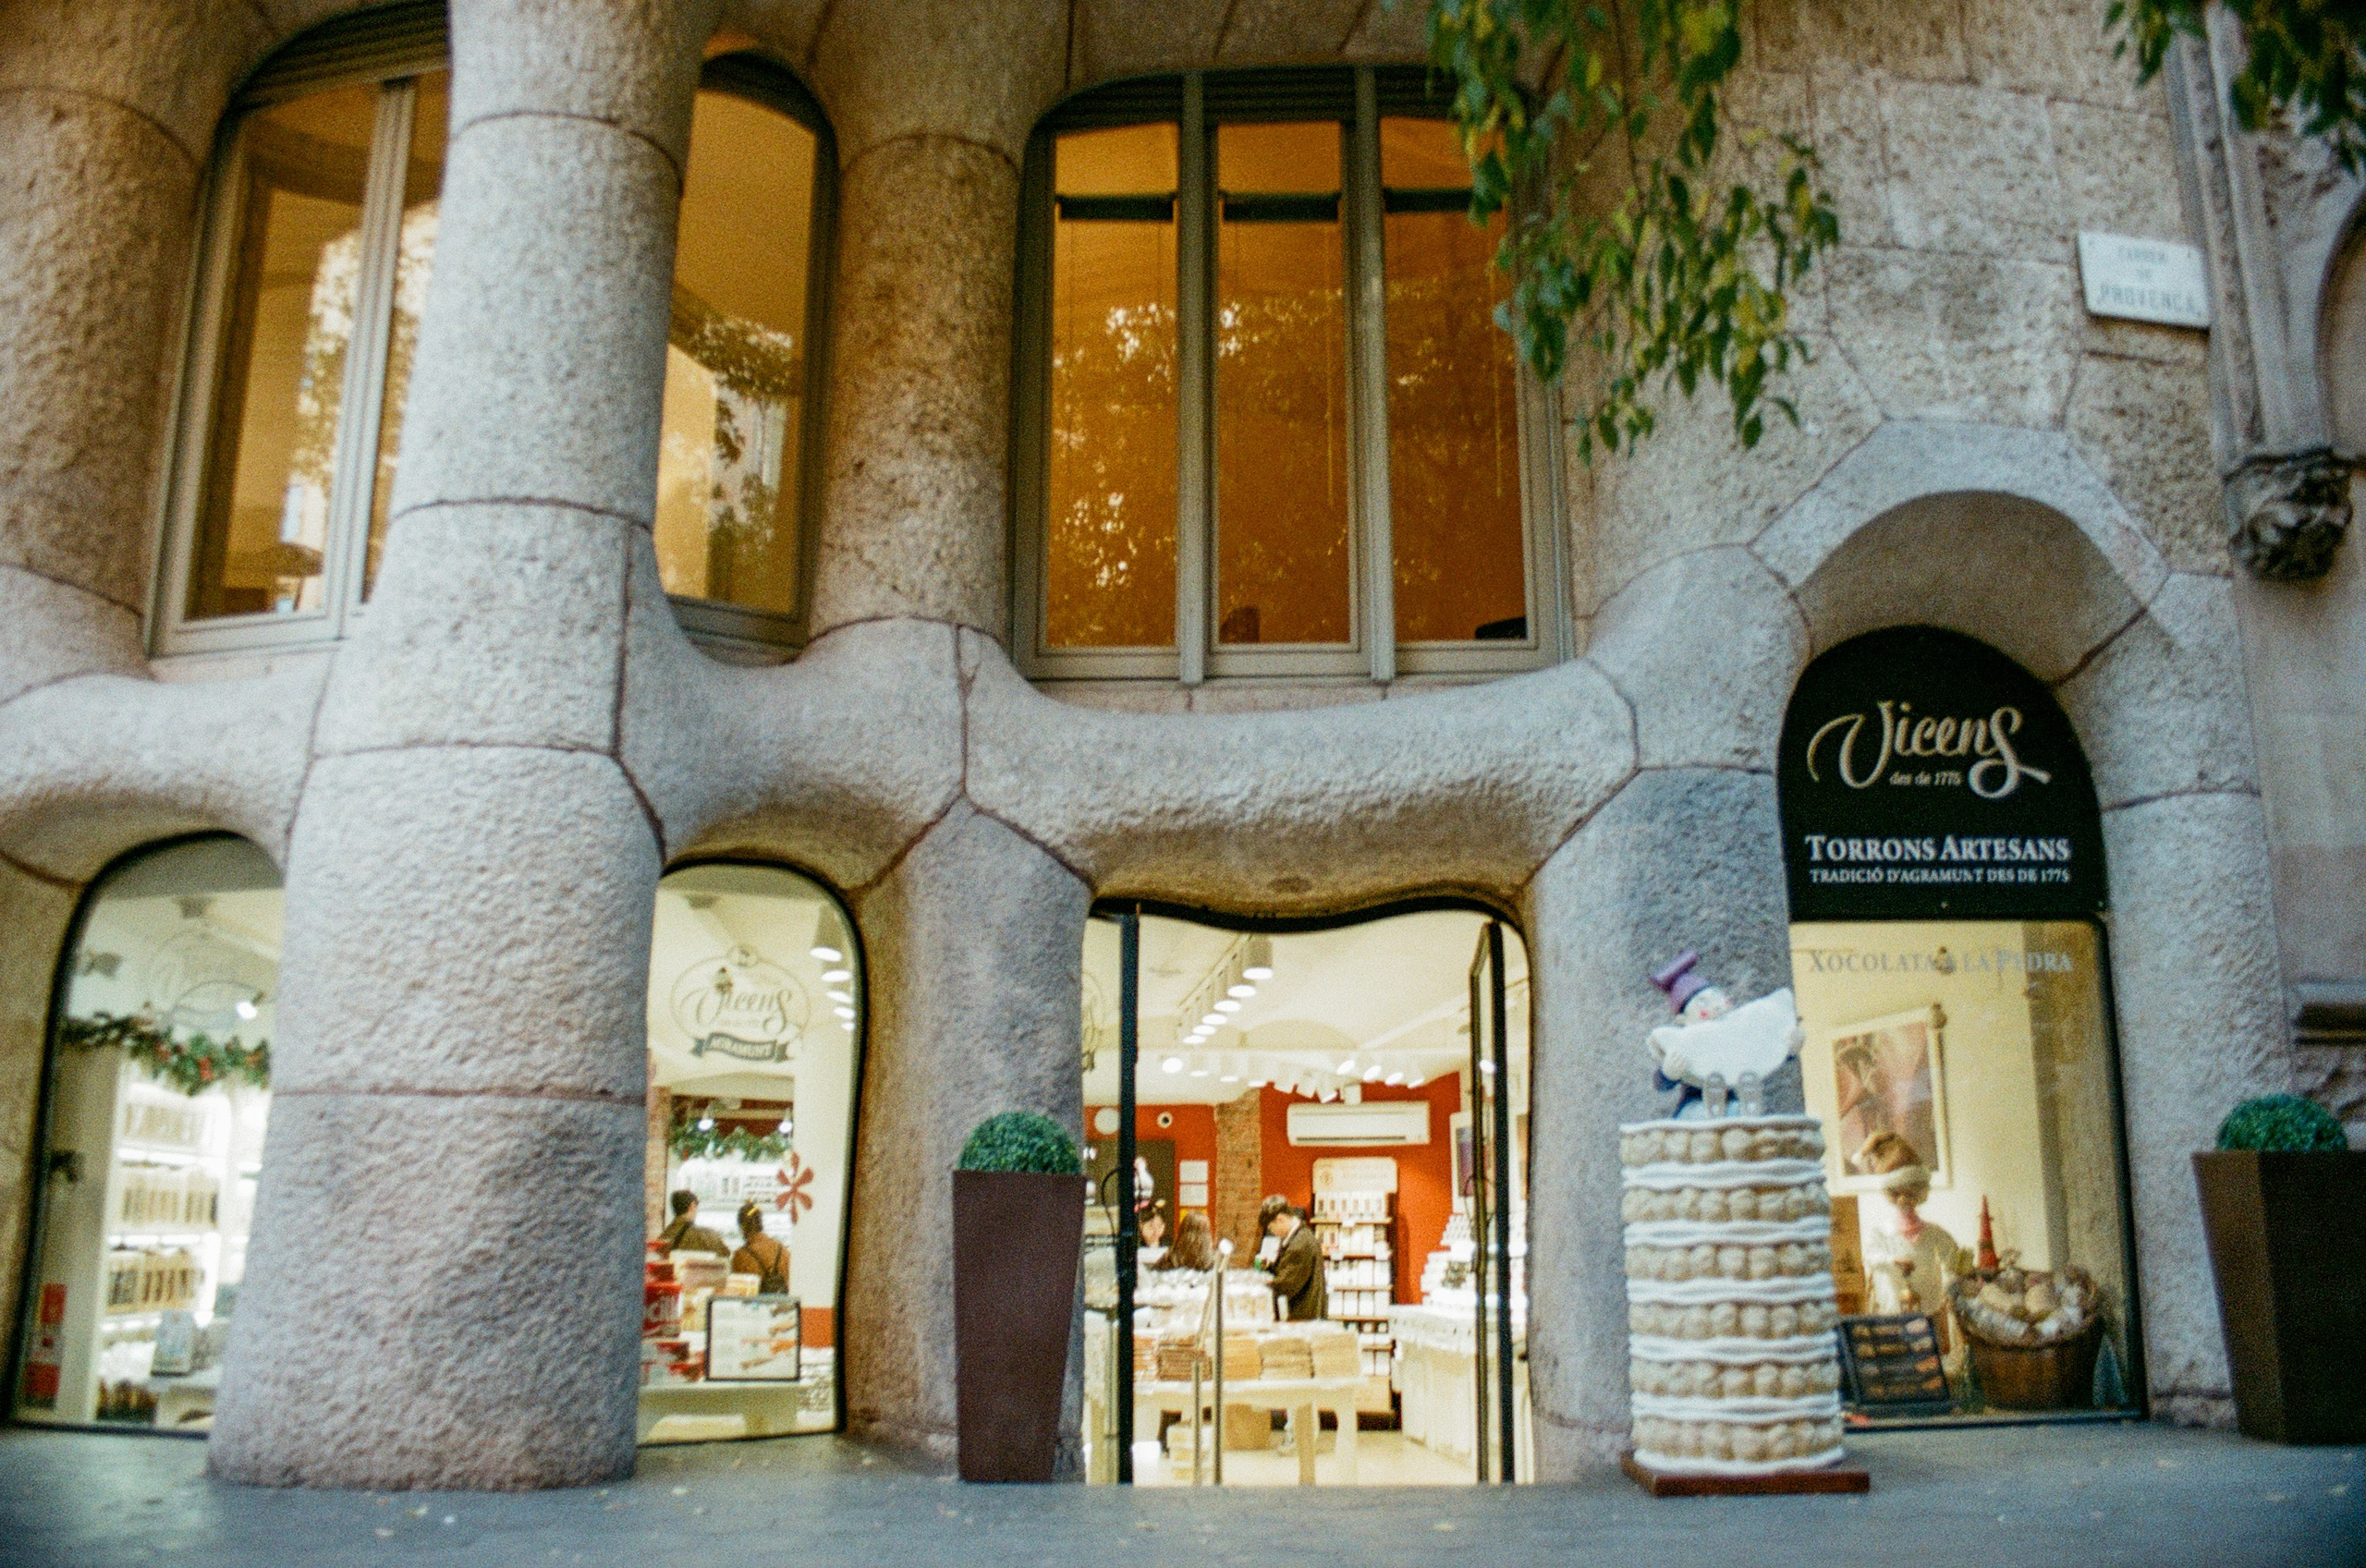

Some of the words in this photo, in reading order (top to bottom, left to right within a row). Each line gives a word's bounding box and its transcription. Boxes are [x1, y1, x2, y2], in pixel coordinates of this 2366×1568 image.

[1805, 834, 1935, 861] TORRONS
[1940, 835, 2071, 861] ARTESANS
[1810, 868, 1884, 883] TRADICIÓ
[1886, 869, 1983, 883] D'AGRAMUNT
[1986, 869, 2015, 883] DES
[2018, 869, 2038, 883] DE
[2041, 869, 2070, 884] 1775
[1810, 951, 1937, 973] XOCOLATA
[1964, 952, 1992, 973] LA
